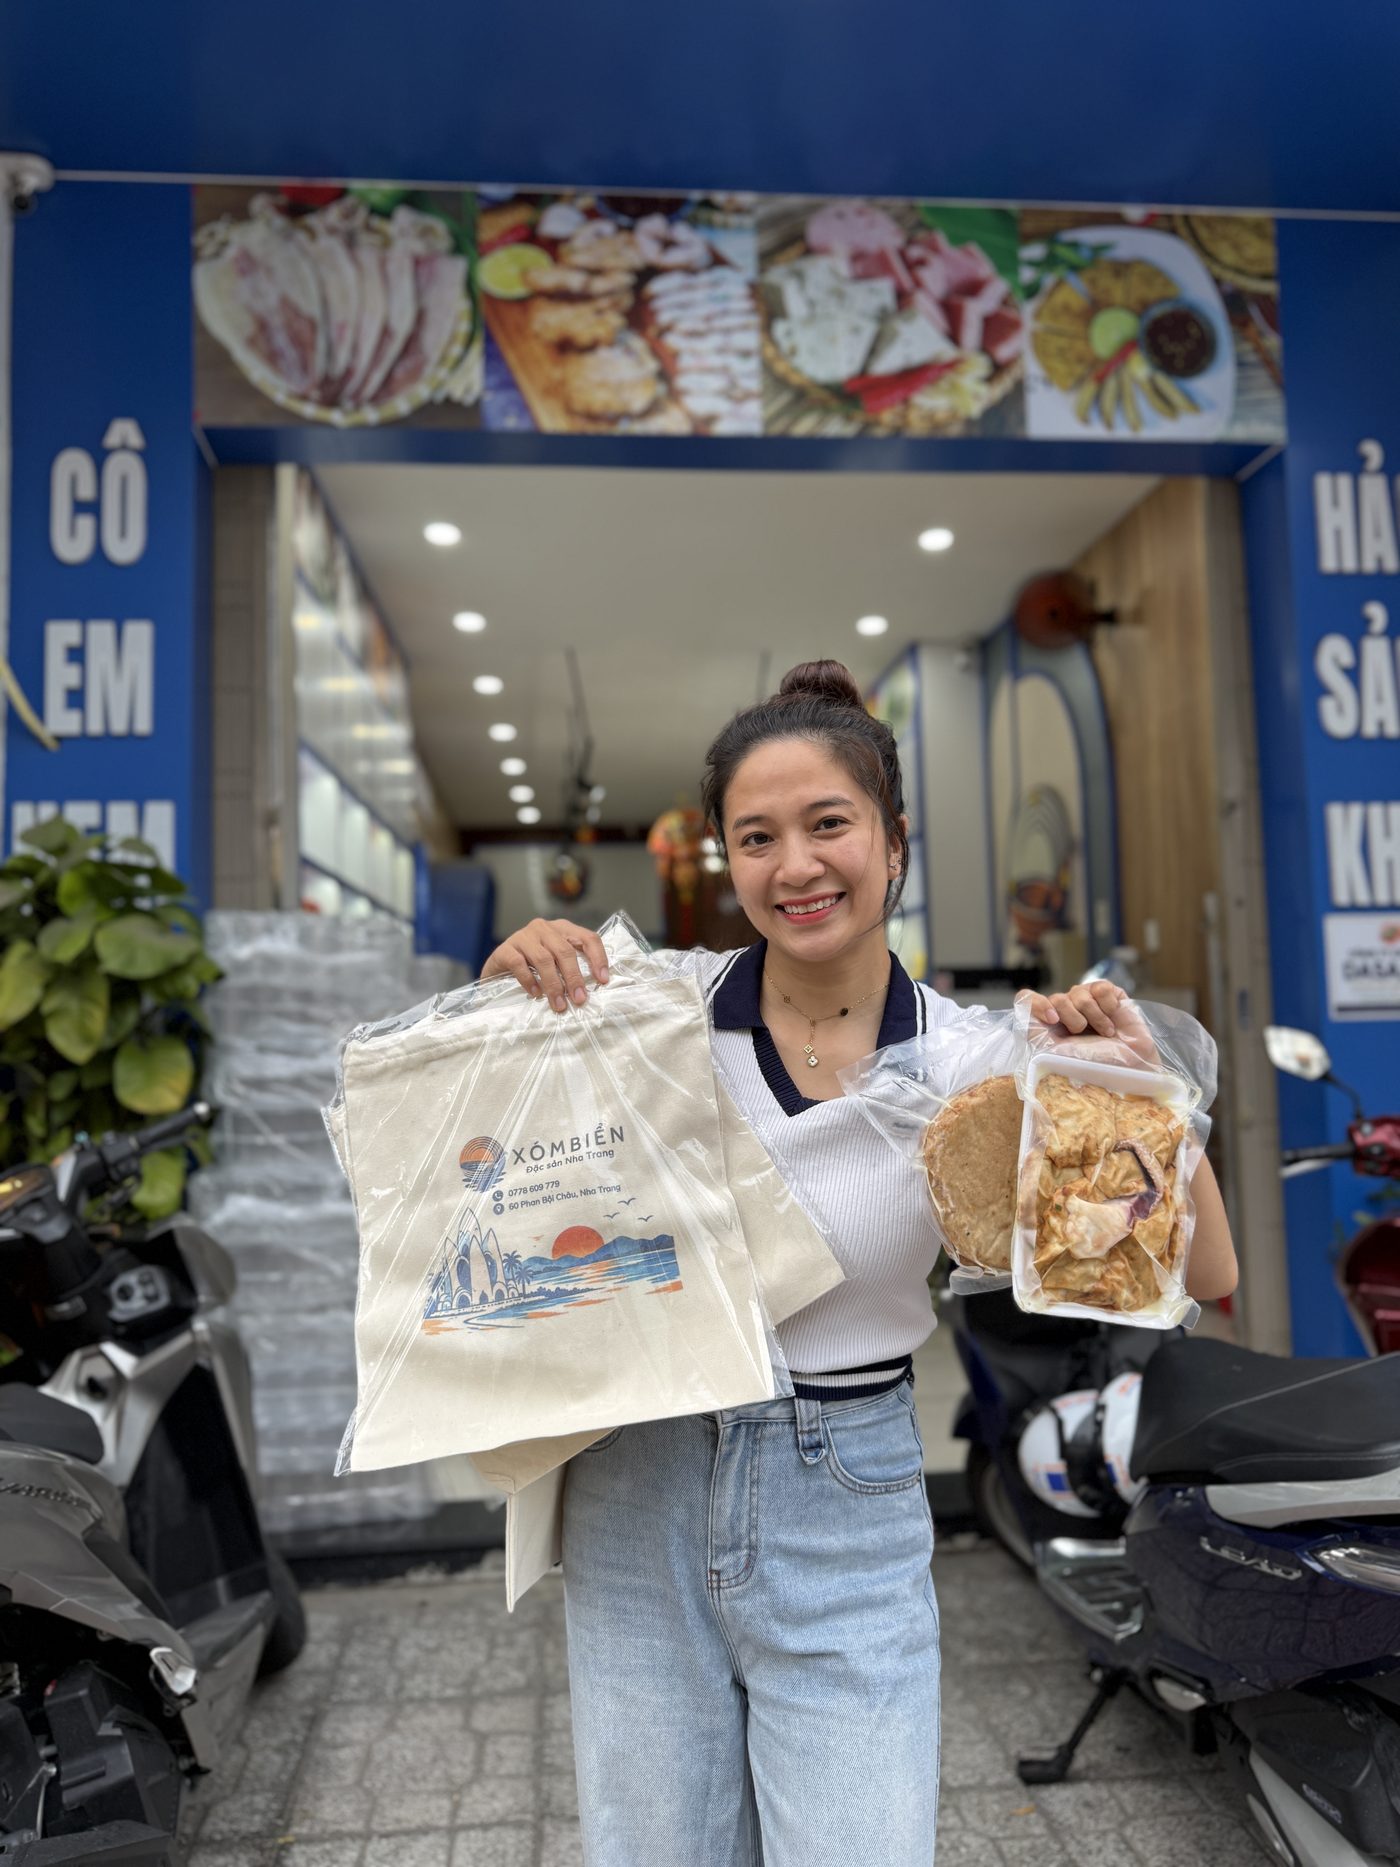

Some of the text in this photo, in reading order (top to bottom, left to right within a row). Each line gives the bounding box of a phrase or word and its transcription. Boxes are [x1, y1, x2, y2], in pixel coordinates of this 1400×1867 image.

[50, 418, 147, 566] CÔ
[1314, 438, 1400, 575] HẢ
[44, 620, 154, 736] EM
[1316, 600, 1400, 740] SẢ
[512, 1122, 625, 1166] XÓMBIỂN
[526, 1149, 615, 1174] Đặc sản Nha Trang
[508, 1180, 560, 1197] 0778 609 779
[508, 1184, 622, 1211] 60 Phan Bội Châu, Nha Trang
